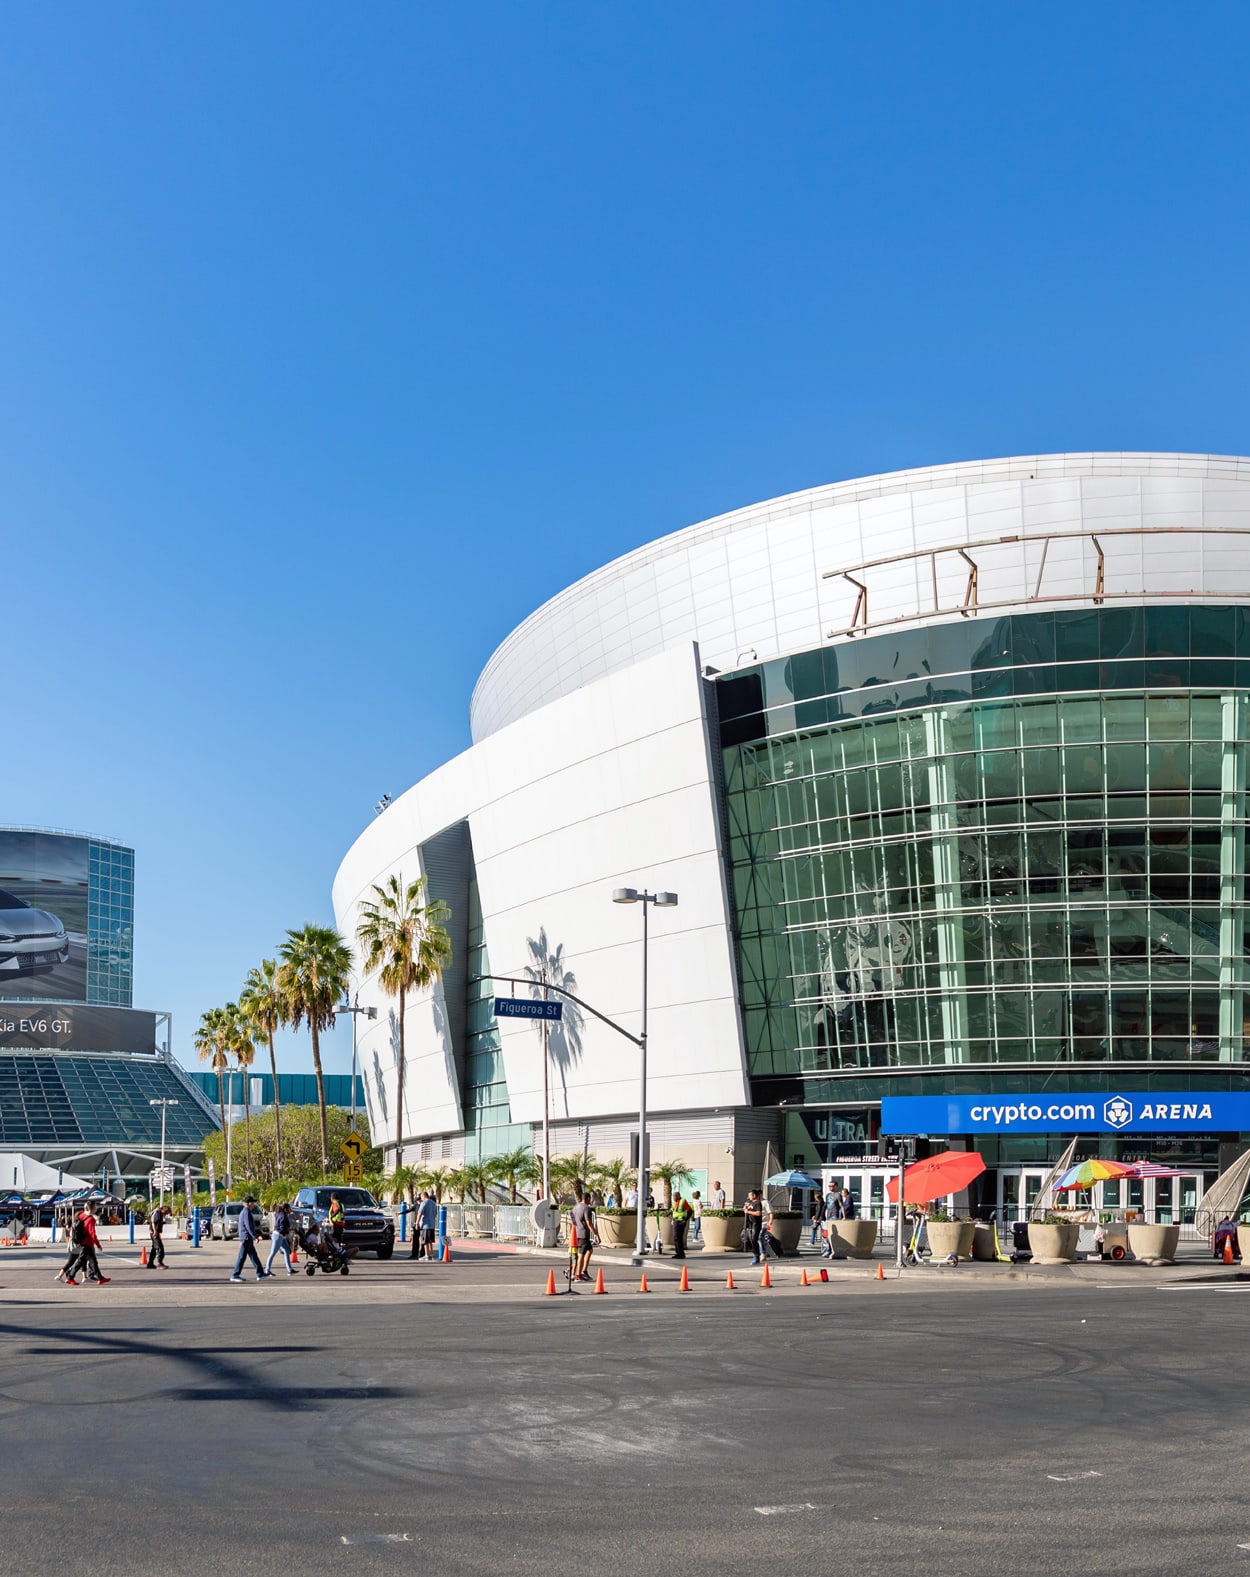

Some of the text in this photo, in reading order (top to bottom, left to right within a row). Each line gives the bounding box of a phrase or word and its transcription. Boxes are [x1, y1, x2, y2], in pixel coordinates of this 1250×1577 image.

[500, 1002, 557, 1015] Figueroa St
[20, 1019, 47, 1032] EV6
[51, 1020, 72, 1033] GT.
[970, 1102, 1213, 1125] crypto.com ARENA
[348, 1165, 360, 1176] 15
